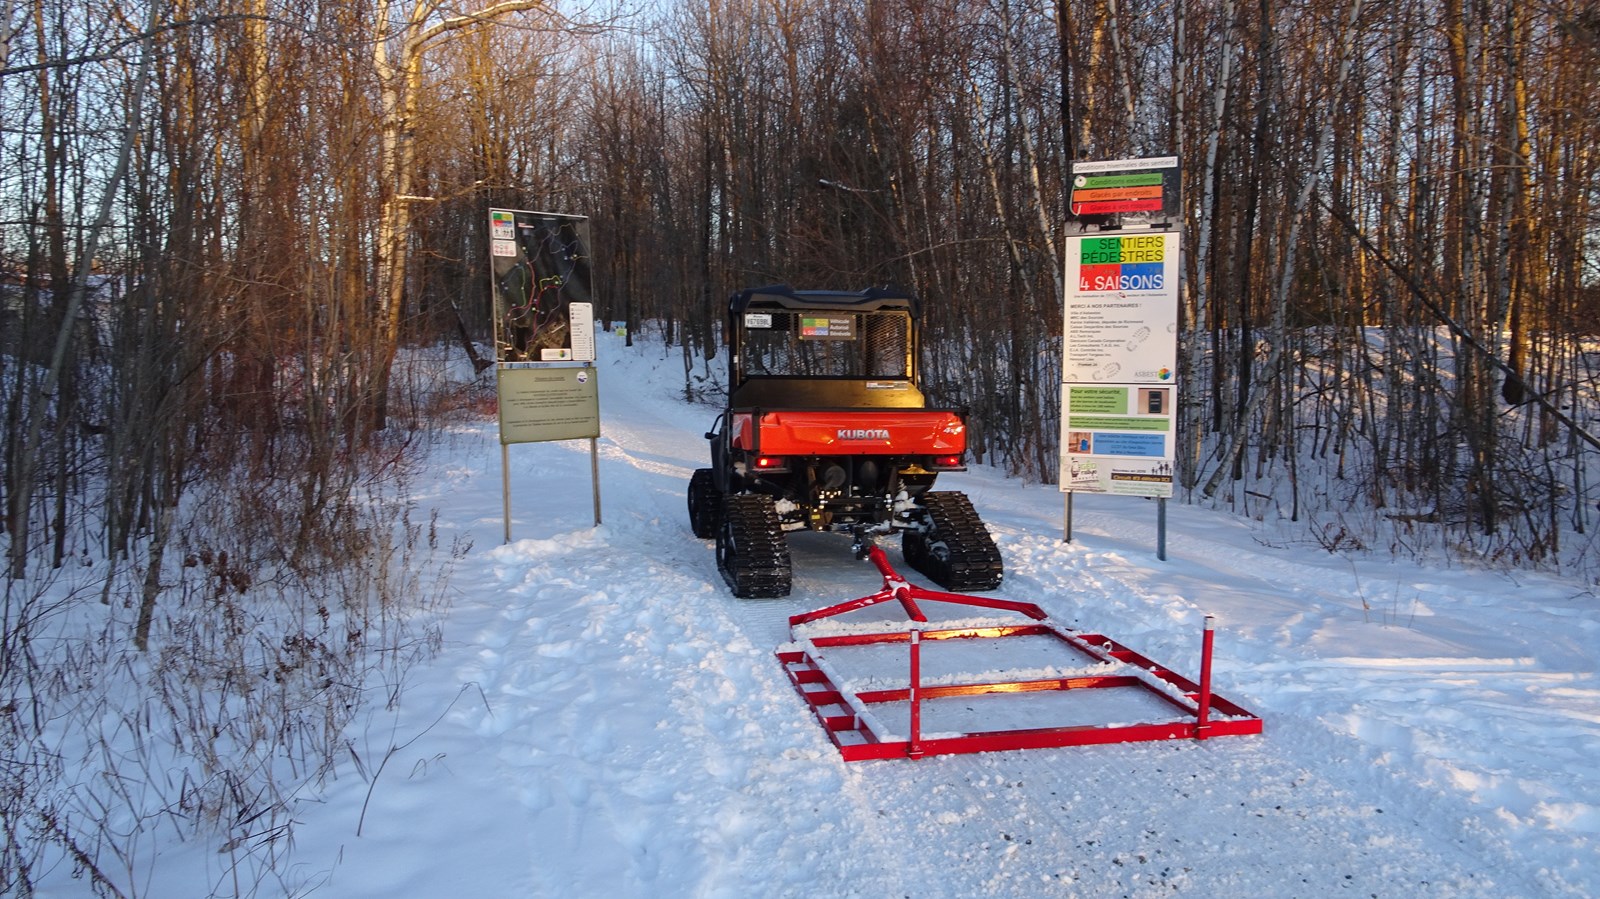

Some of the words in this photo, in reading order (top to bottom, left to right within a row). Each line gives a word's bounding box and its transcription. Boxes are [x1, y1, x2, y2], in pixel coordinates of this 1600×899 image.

[1100, 236, 1164, 250] SENTIERS
[1082, 250, 1164, 263] PÉDESTRES
[1080, 276, 1090, 290] 4
[1094, 274, 1163, 290] SAISONS
[838, 430, 890, 439] KUBOTA
